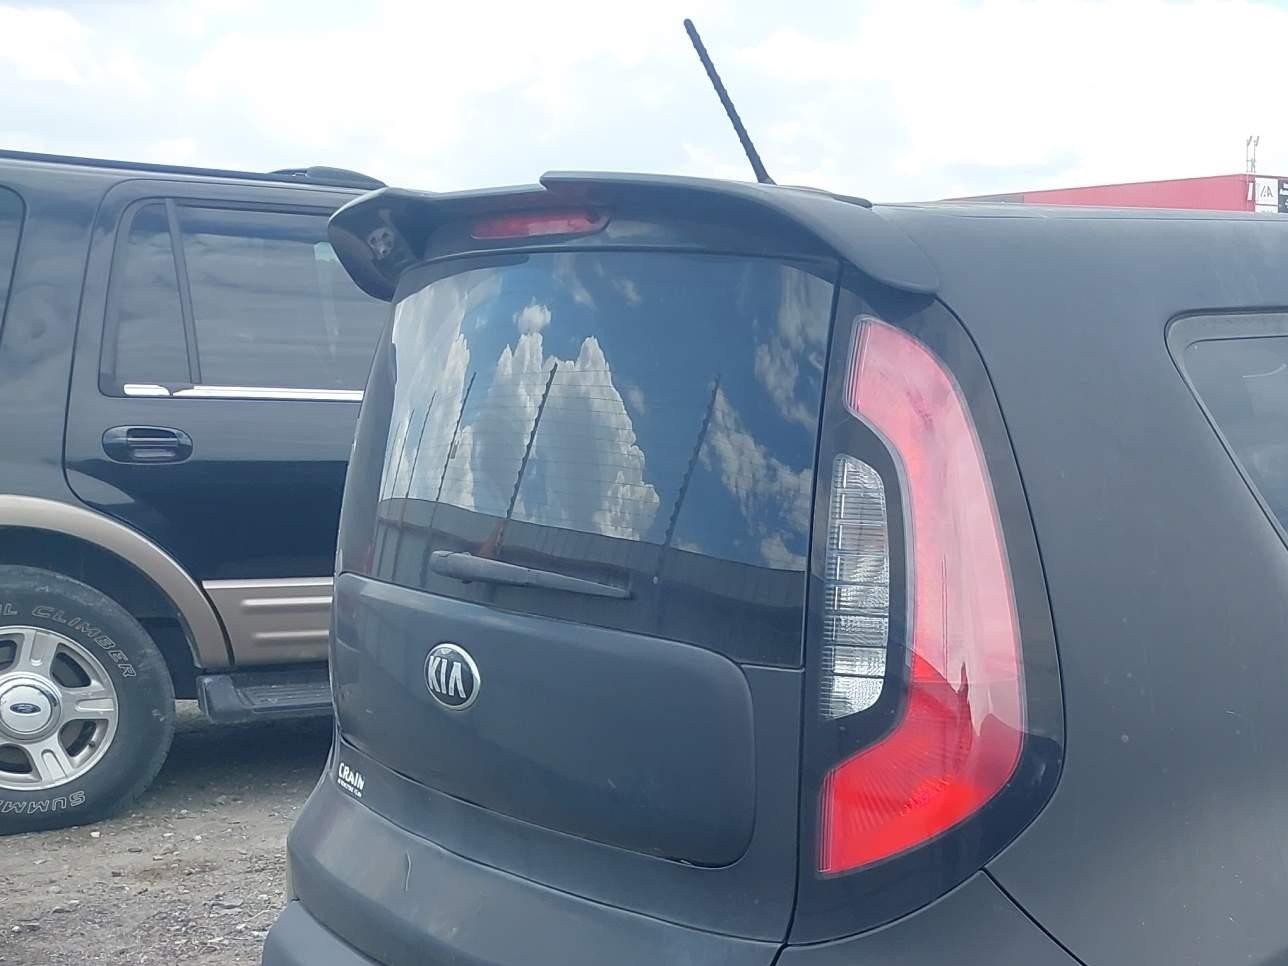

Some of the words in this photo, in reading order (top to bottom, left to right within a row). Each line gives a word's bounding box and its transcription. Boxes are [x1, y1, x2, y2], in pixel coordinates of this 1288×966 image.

[32, 605, 136, 677] CLIMBER
[427, 655, 467, 698] KIA
[338, 762, 365, 790] CRAIN
[0, 790, 86, 814] SUMM
